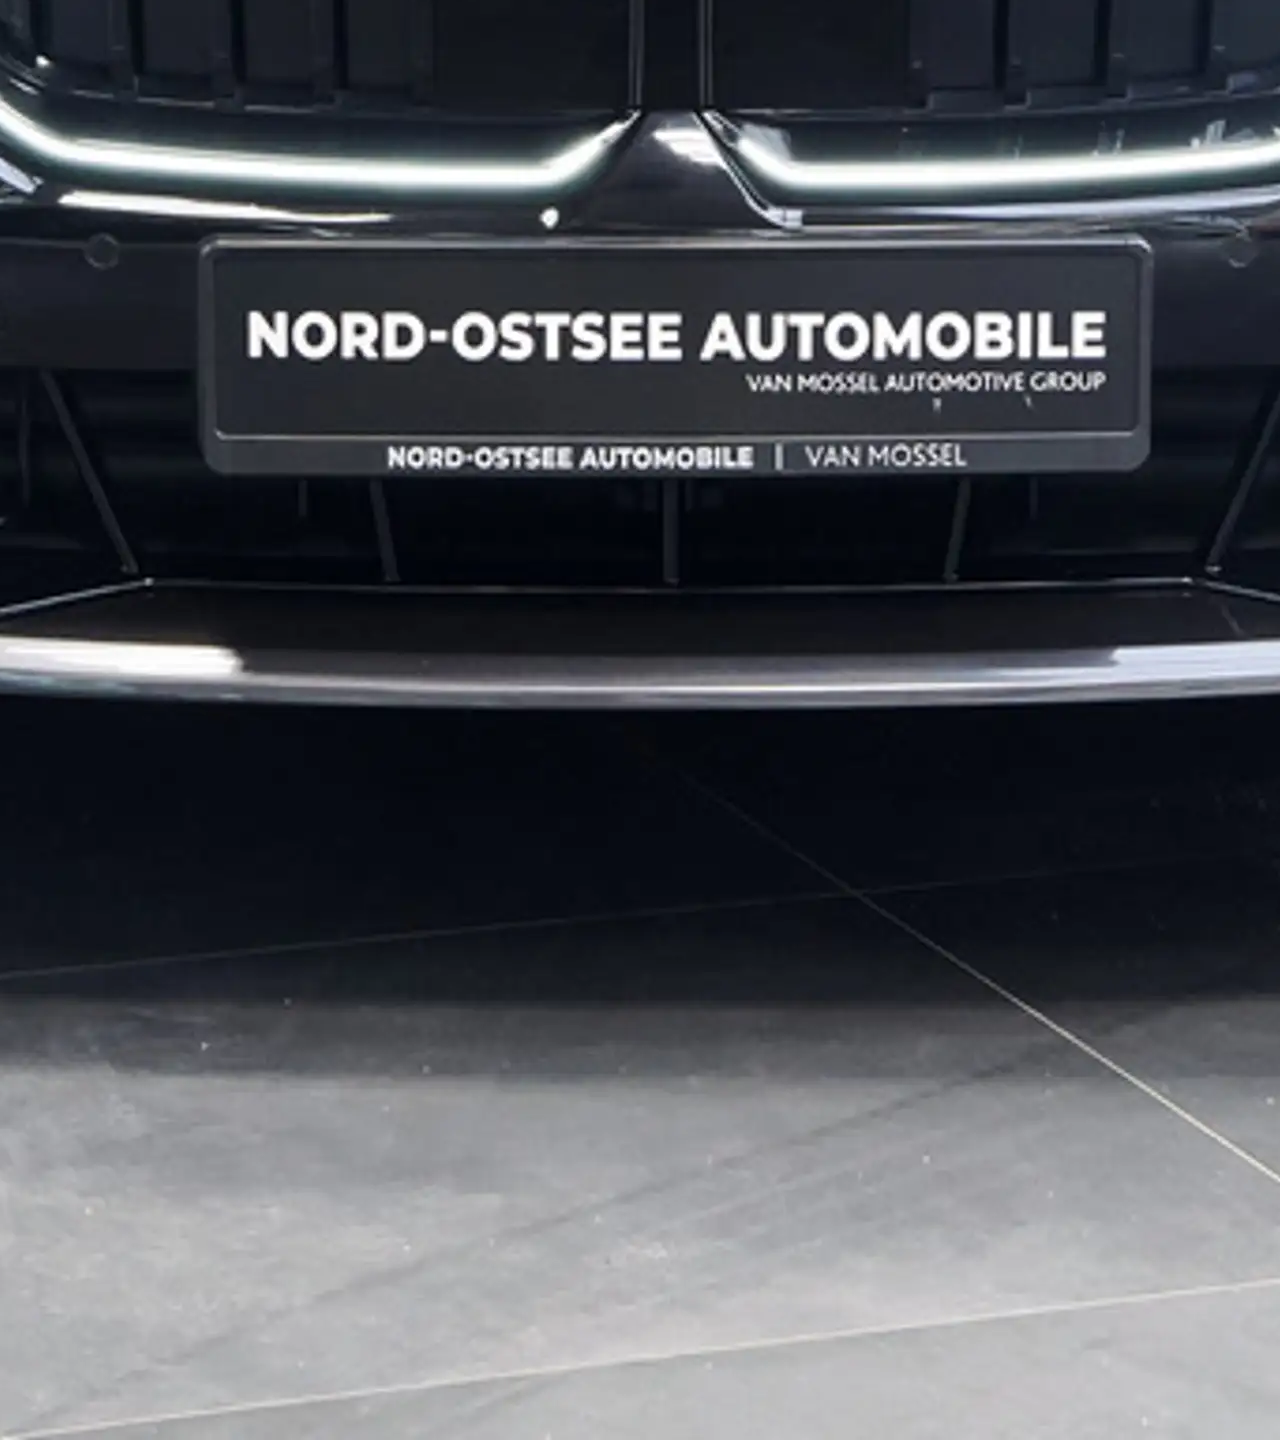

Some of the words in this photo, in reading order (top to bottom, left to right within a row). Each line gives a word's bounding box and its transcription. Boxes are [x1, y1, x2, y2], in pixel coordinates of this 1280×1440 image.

[249, 311, 682, 361] NORD-OSTSEE
[700, 311, 1106, 361] AUTOMOBILE
[745, 373, 792, 392] VAN
[798, 372, 879, 393] MOSSEL
[884, 371, 1024, 392] AUTOMOTIVE
[1030, 371, 1106, 392] GROUP
[387, 446, 573, 469] NORD-OSTSEE
[580, 446, 753, 469] AUTOMOBILE
[805, 446, 860, 467] VAN
[868, 444, 967, 467] MOSSEL
